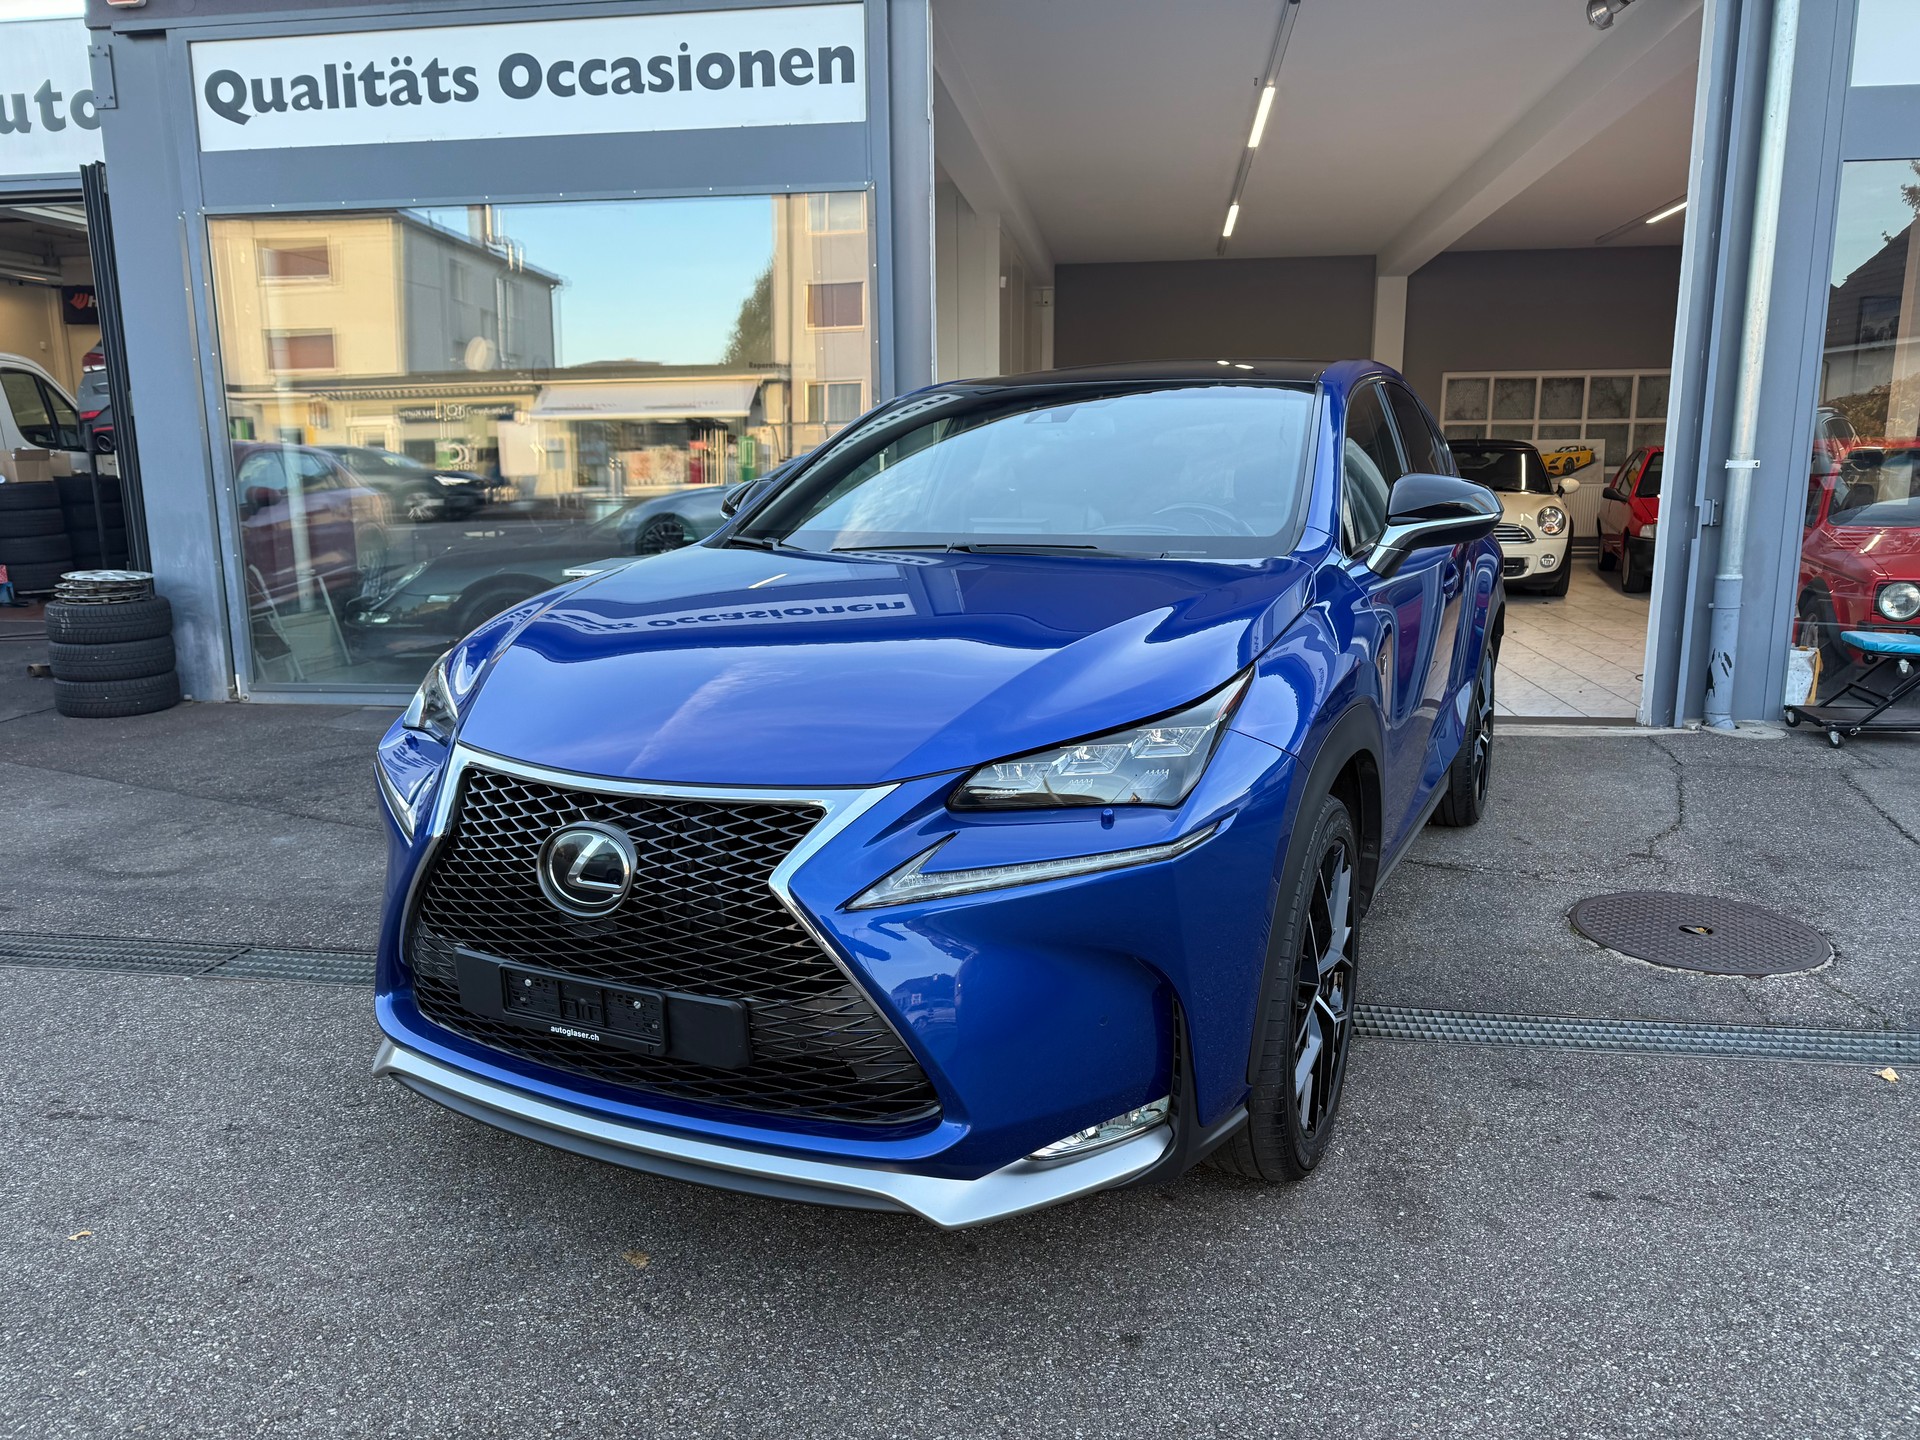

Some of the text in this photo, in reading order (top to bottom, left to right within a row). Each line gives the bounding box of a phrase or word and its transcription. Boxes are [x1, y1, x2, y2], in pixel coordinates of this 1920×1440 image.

[204, 41, 856, 126] Qualitäts Occasionen
[550, 1025, 600, 1042] autoglaser.ch
